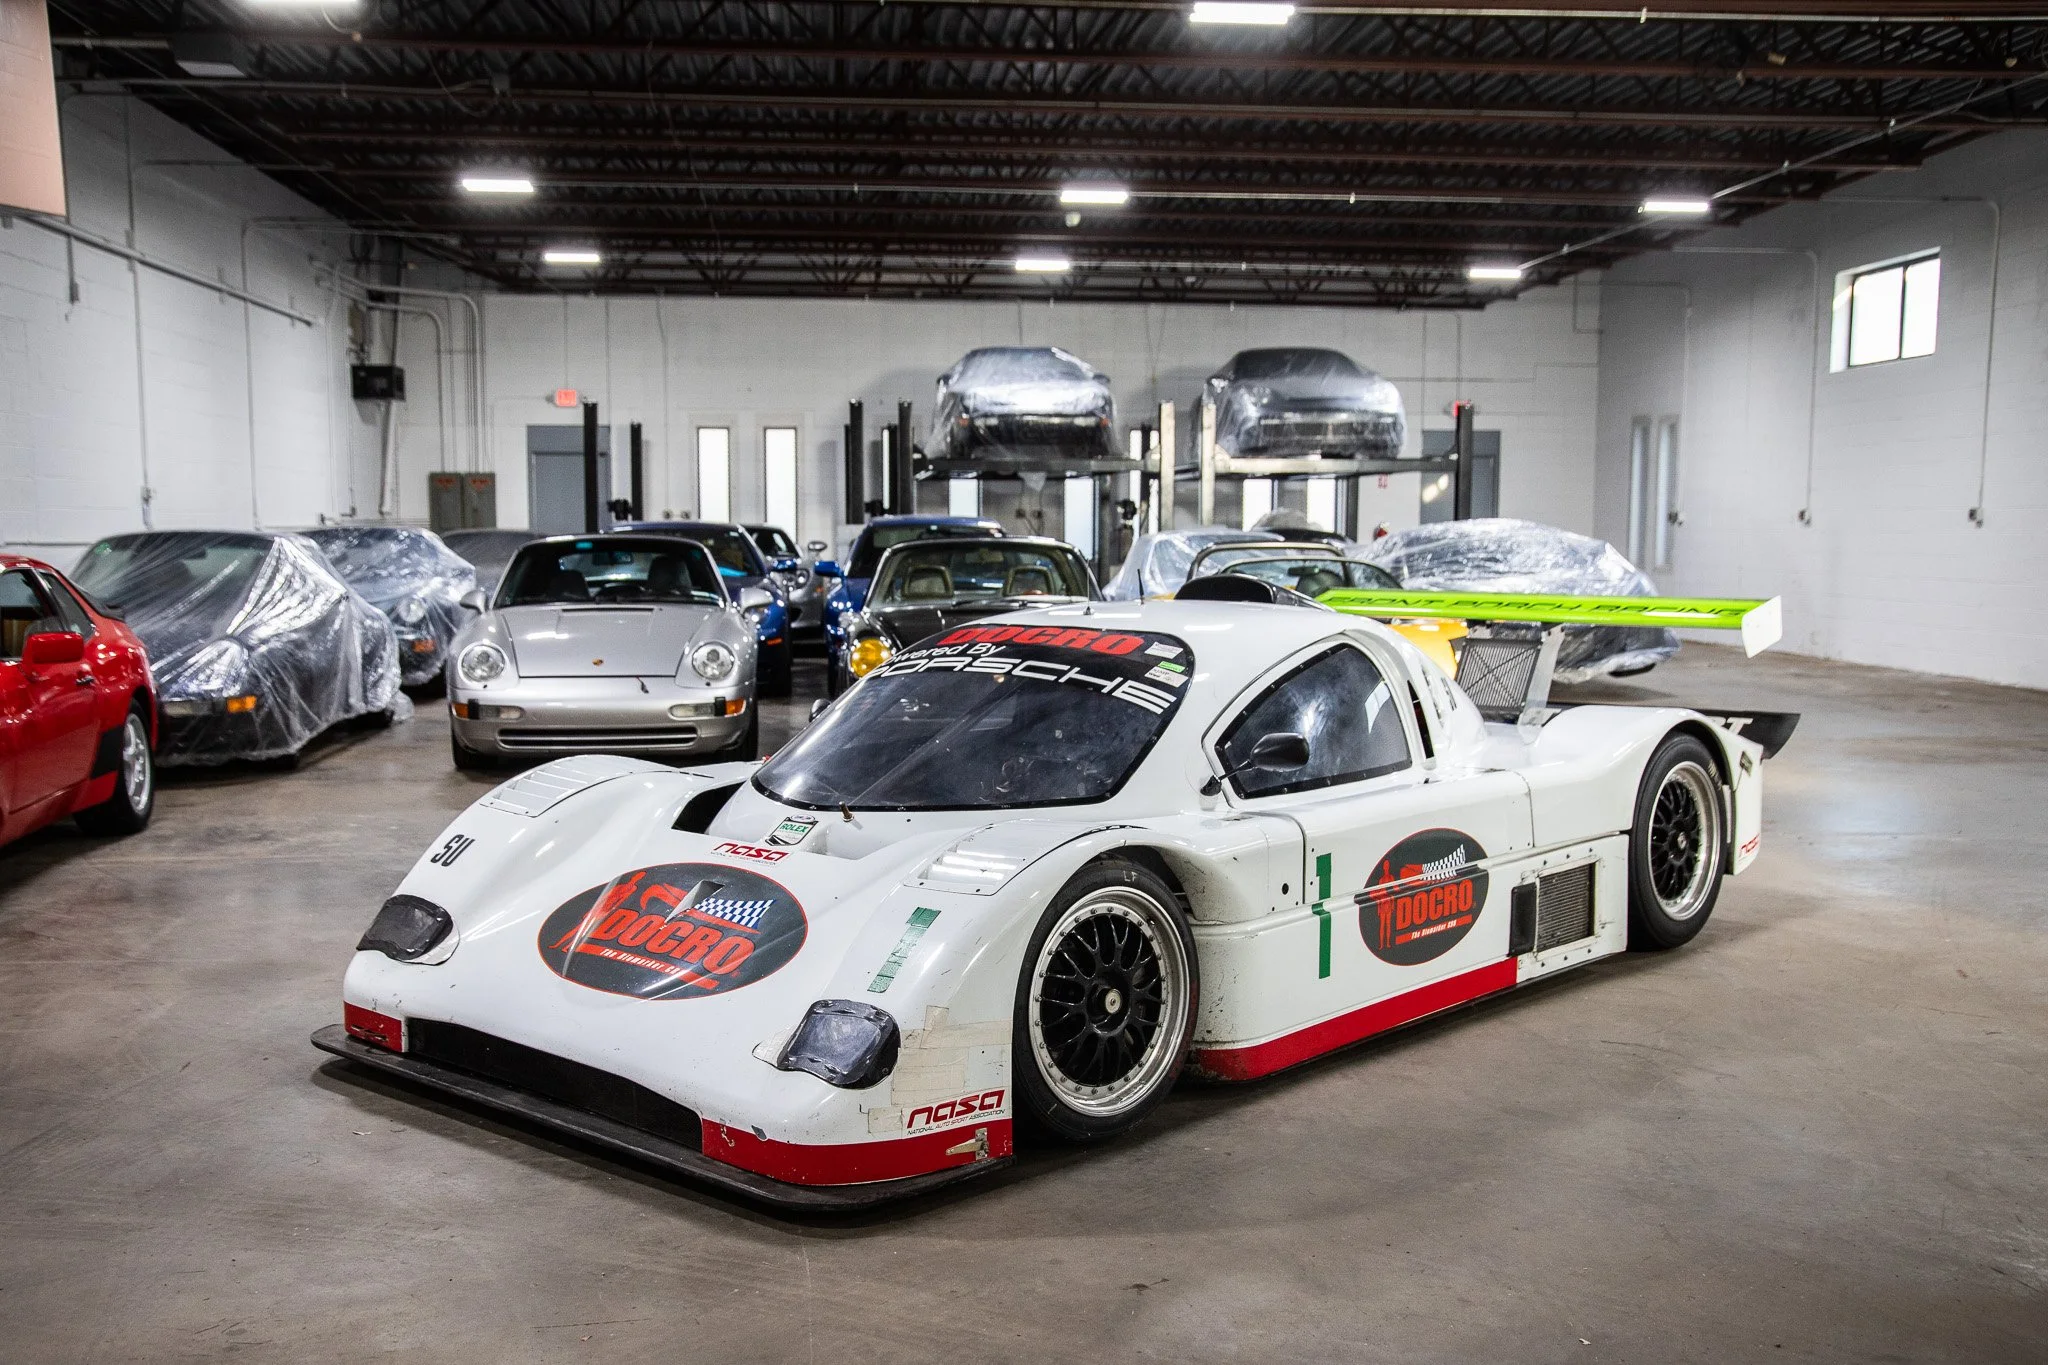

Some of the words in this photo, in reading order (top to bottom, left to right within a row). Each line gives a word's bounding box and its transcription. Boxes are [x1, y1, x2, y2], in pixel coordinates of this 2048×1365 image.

[1322, 596, 1445, 607] FRONT
[1446, 600, 1582, 611] PORCH
[936, 625, 1145, 655] DOCRO
[966, 642, 1006, 657] By
[860, 656, 1178, 715] PORSCHE
[780, 823, 808, 833] ROLEX
[430, 834, 475, 867] SU
[713, 842, 790, 862] nasa
[1396, 879, 1474, 931] DOCRO
[588, 907, 756, 976] DOCRO
[599, 948, 618, 958] The
[906, 1089, 1006, 1129] nasa
[906, 1125, 935, 1136] NATIONAL
[935, 1121, 950, 1130] AUTO
[950, 1116, 969, 1127] SPORT
[968, 1109, 1006, 1121] ASSOCIATION
